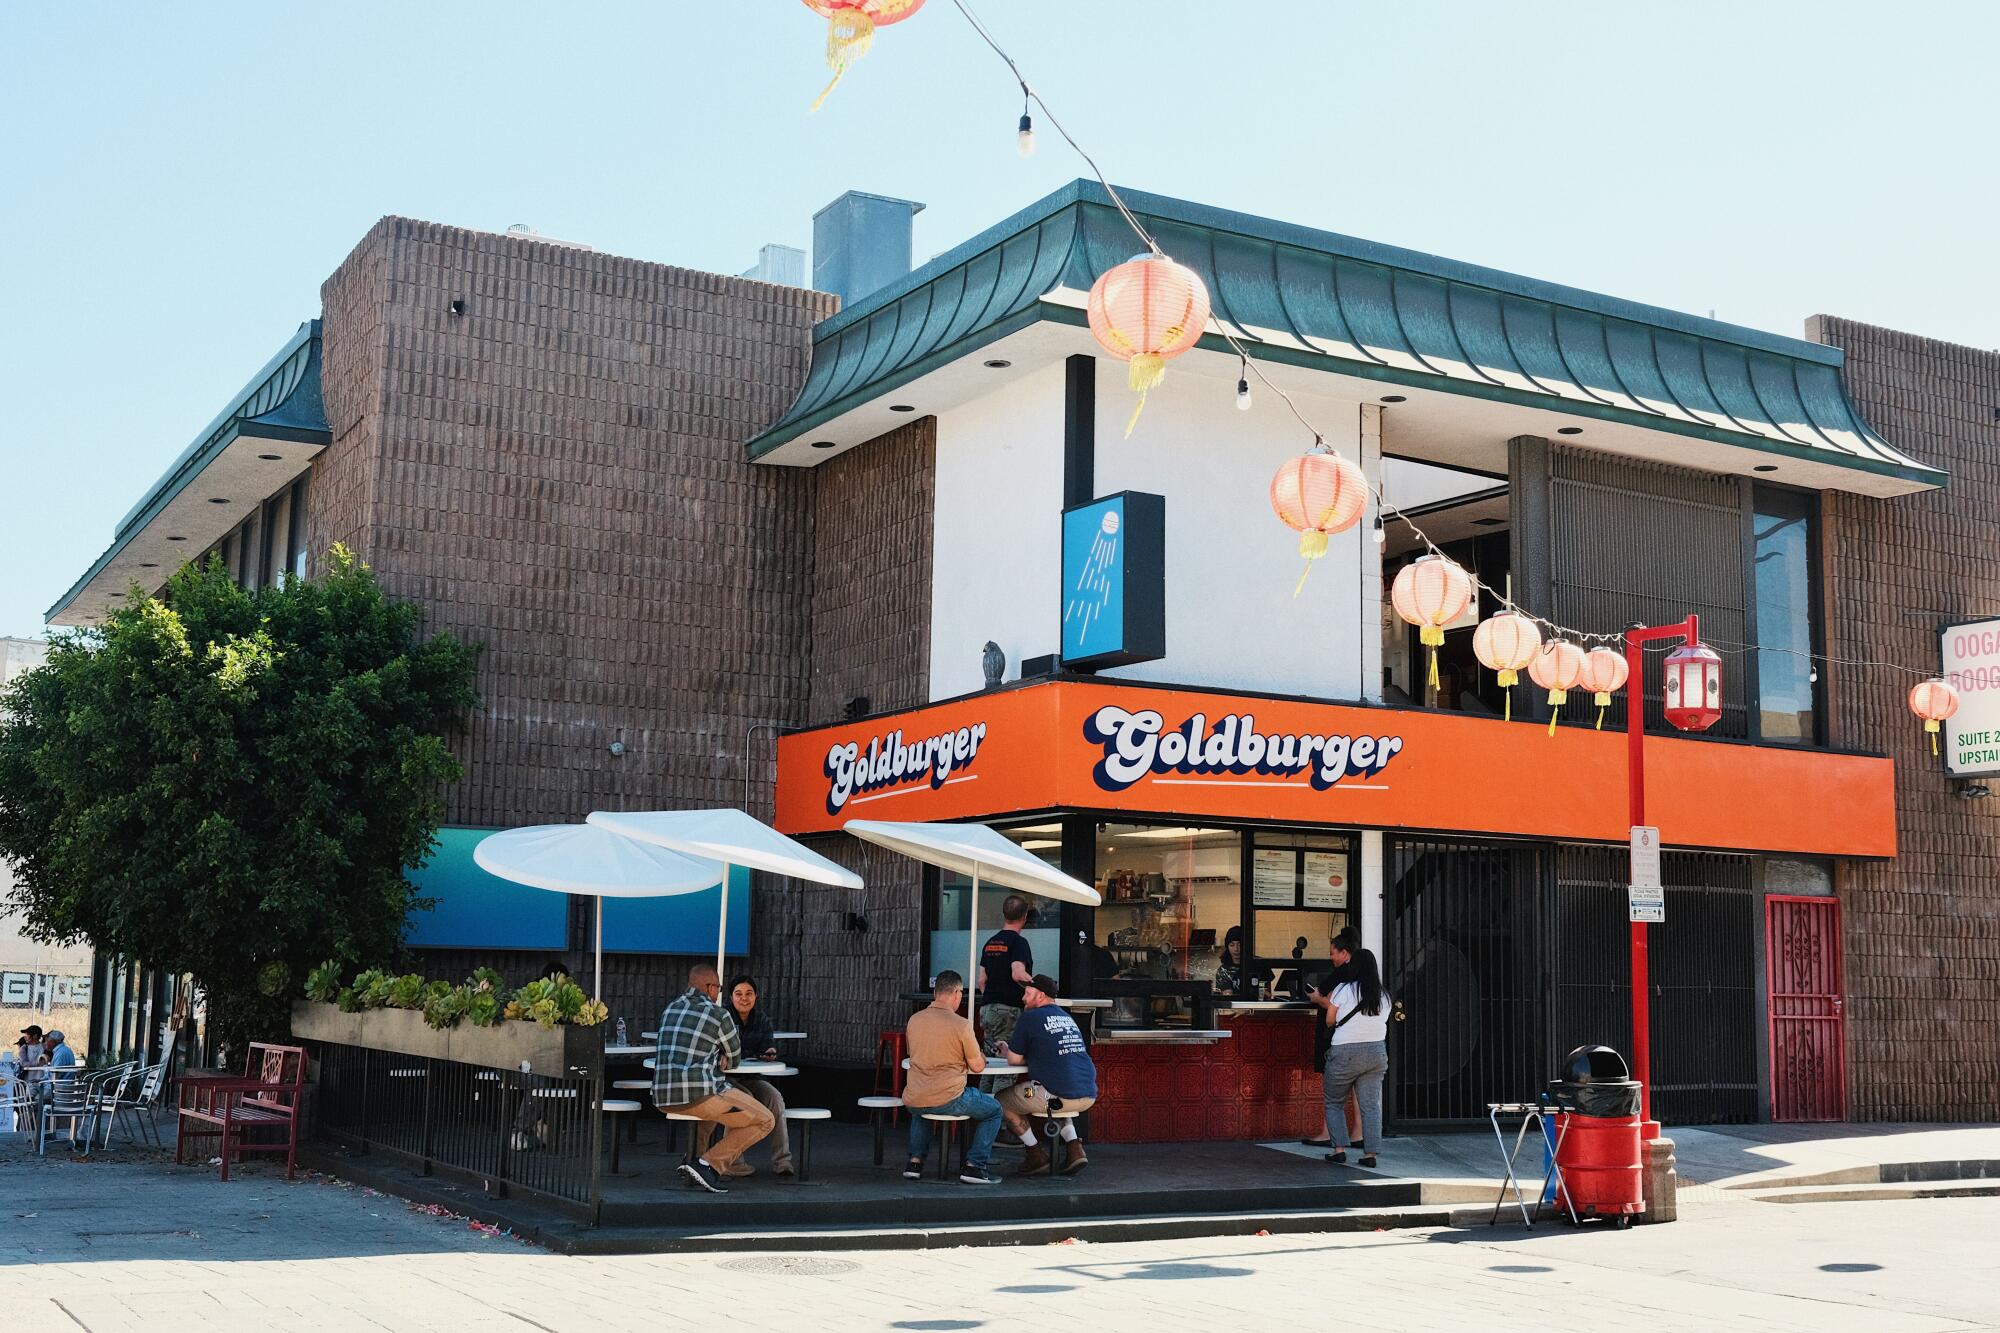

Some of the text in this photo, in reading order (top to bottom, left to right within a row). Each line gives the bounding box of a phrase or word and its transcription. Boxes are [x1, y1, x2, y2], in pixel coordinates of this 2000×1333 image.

[824, 721, 987, 816] Goldburger
[1083, 705, 1403, 792] Goldburger
[1958, 731, 1991, 747] SUITE
